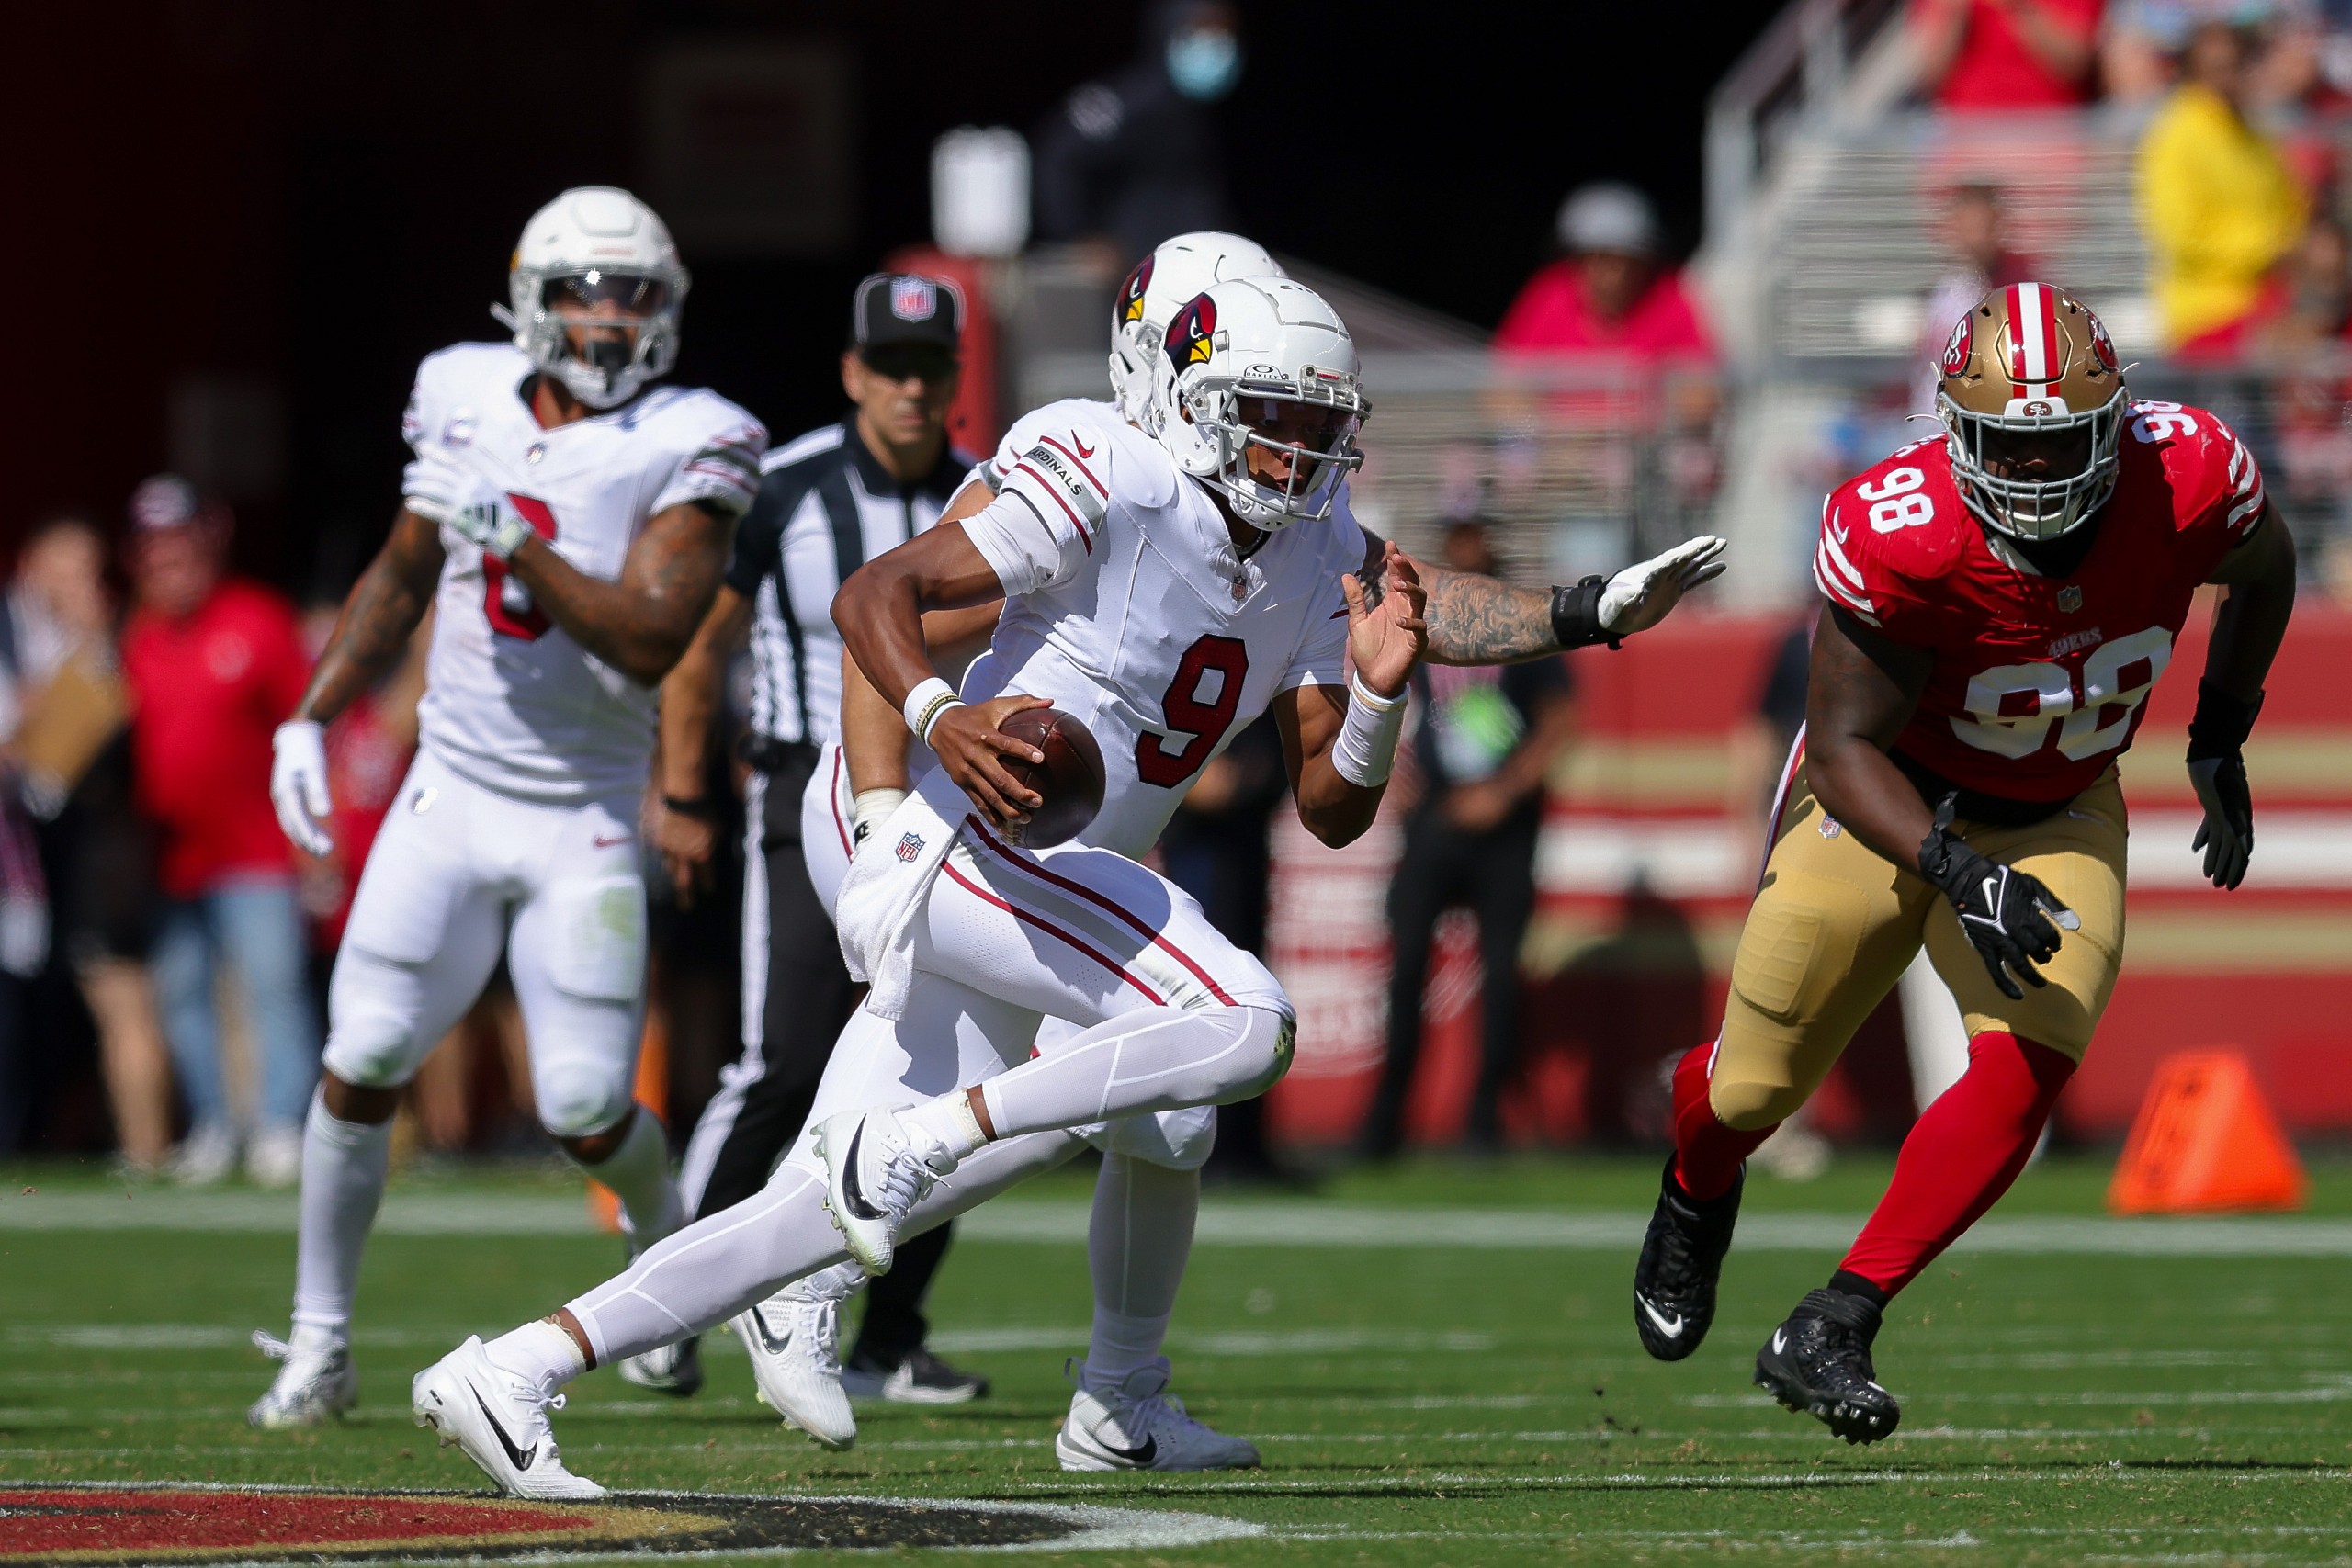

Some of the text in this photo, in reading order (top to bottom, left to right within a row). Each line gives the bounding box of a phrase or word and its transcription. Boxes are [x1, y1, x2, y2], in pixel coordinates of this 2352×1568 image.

[1856, 467, 1936, 535] 98
[1134, 633, 1250, 790] 9
[1948, 625, 2173, 761] 98
[897, 840, 919, 861] NFL
